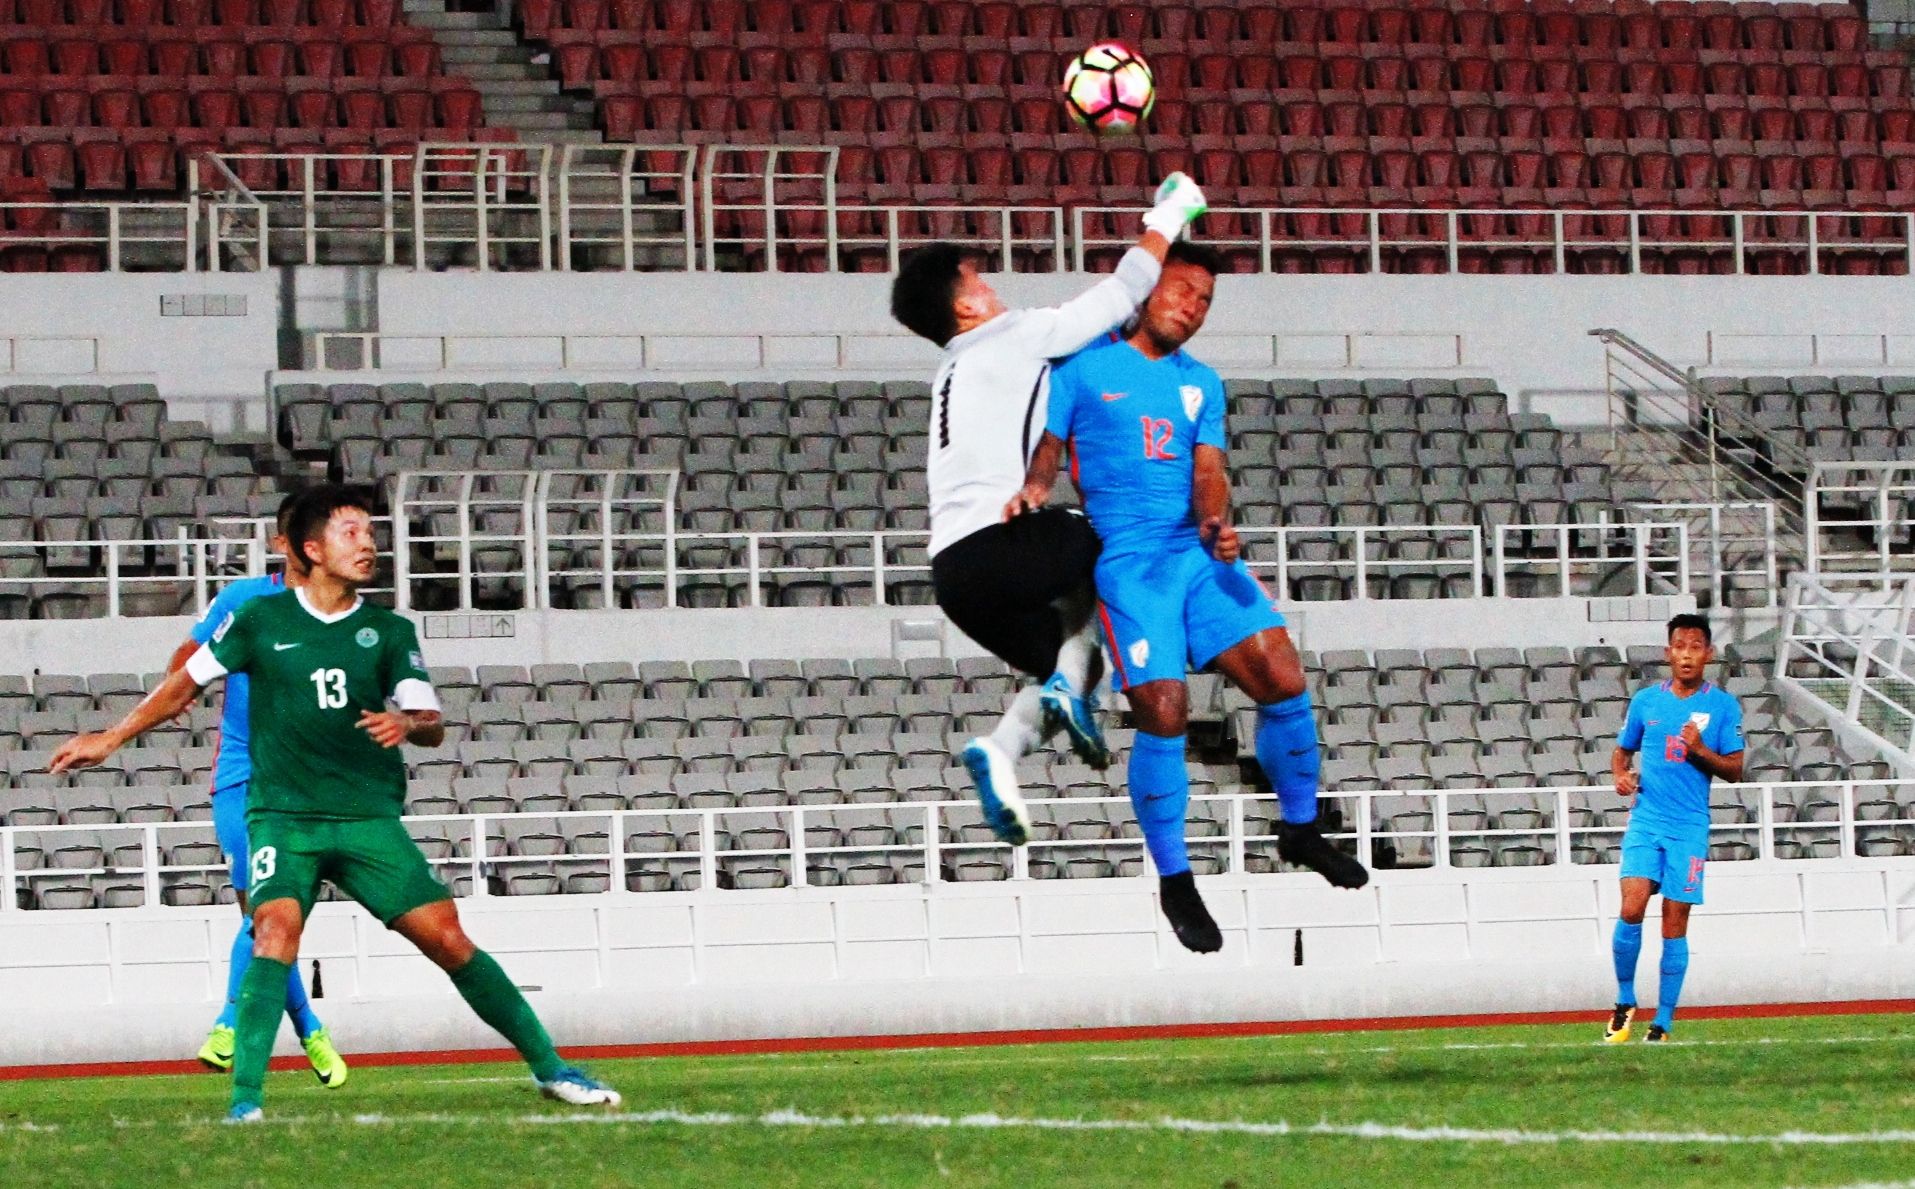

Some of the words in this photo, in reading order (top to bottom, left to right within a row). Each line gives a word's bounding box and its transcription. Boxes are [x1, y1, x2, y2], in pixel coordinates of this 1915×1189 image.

[1140, 416, 1176, 459] 12
[310, 668, 348, 709] 13
[251, 846, 276, 885] 13
